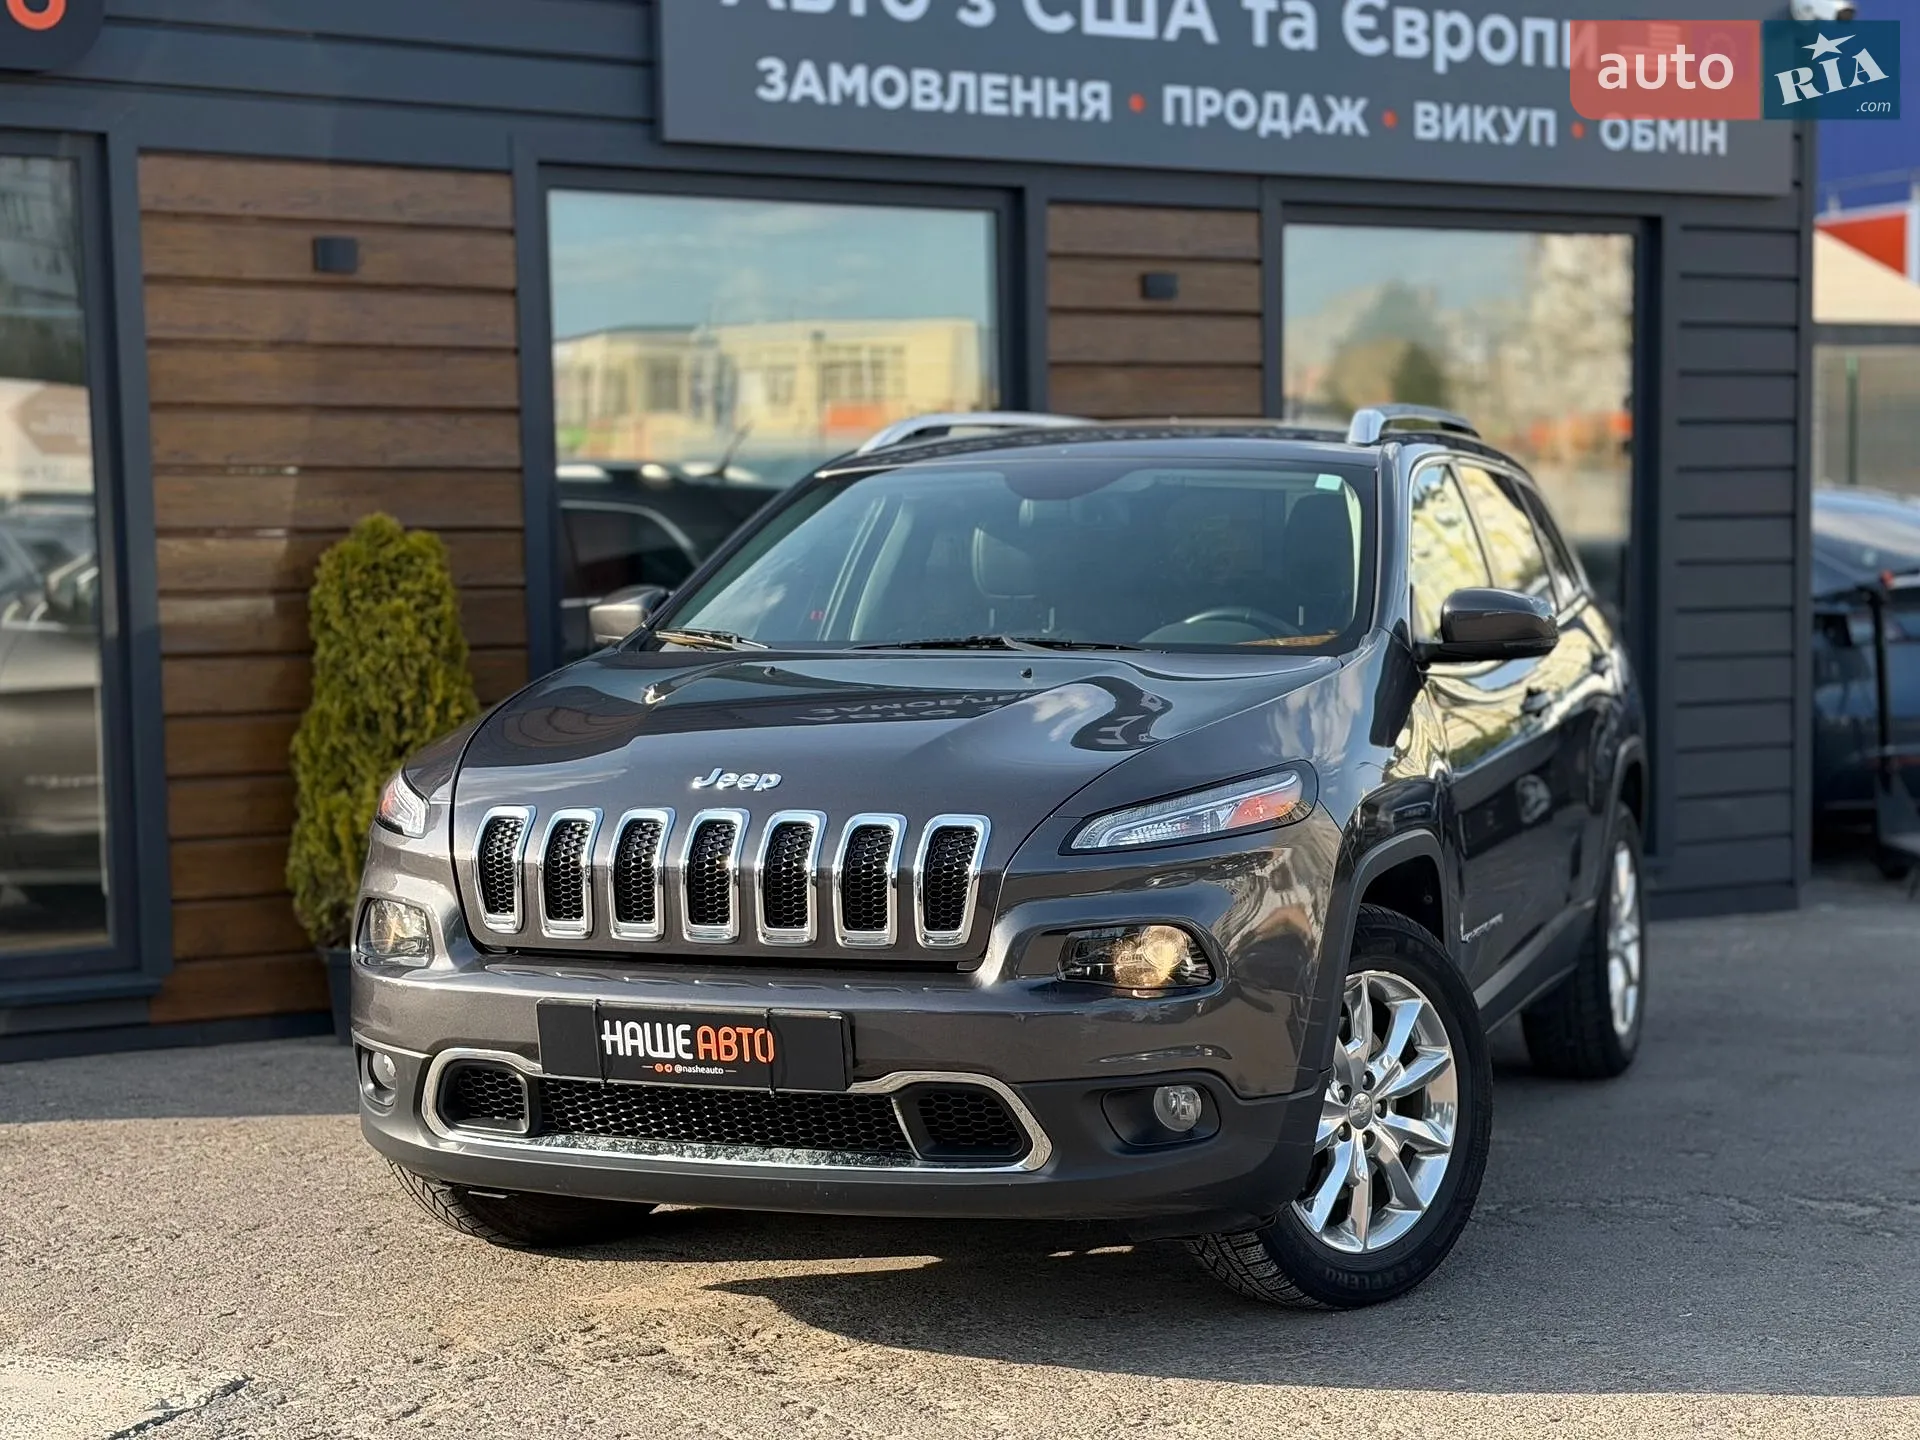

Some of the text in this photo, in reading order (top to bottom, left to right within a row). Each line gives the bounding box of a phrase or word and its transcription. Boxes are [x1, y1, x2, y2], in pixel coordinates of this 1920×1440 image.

[1022, 0, 1220, 44] США
[1241, 0, 1319, 50] та
[756, 57, 1728, 156] ЗАМОВЛЕННЯ ПРОДАЖ ВИКУП ОБМІН
[691, 767, 782, 792] Jeep
[601, 1019, 775, 1063] НАШЕ АВТО
[674, 1064, 724, 1075] @nasheauto
